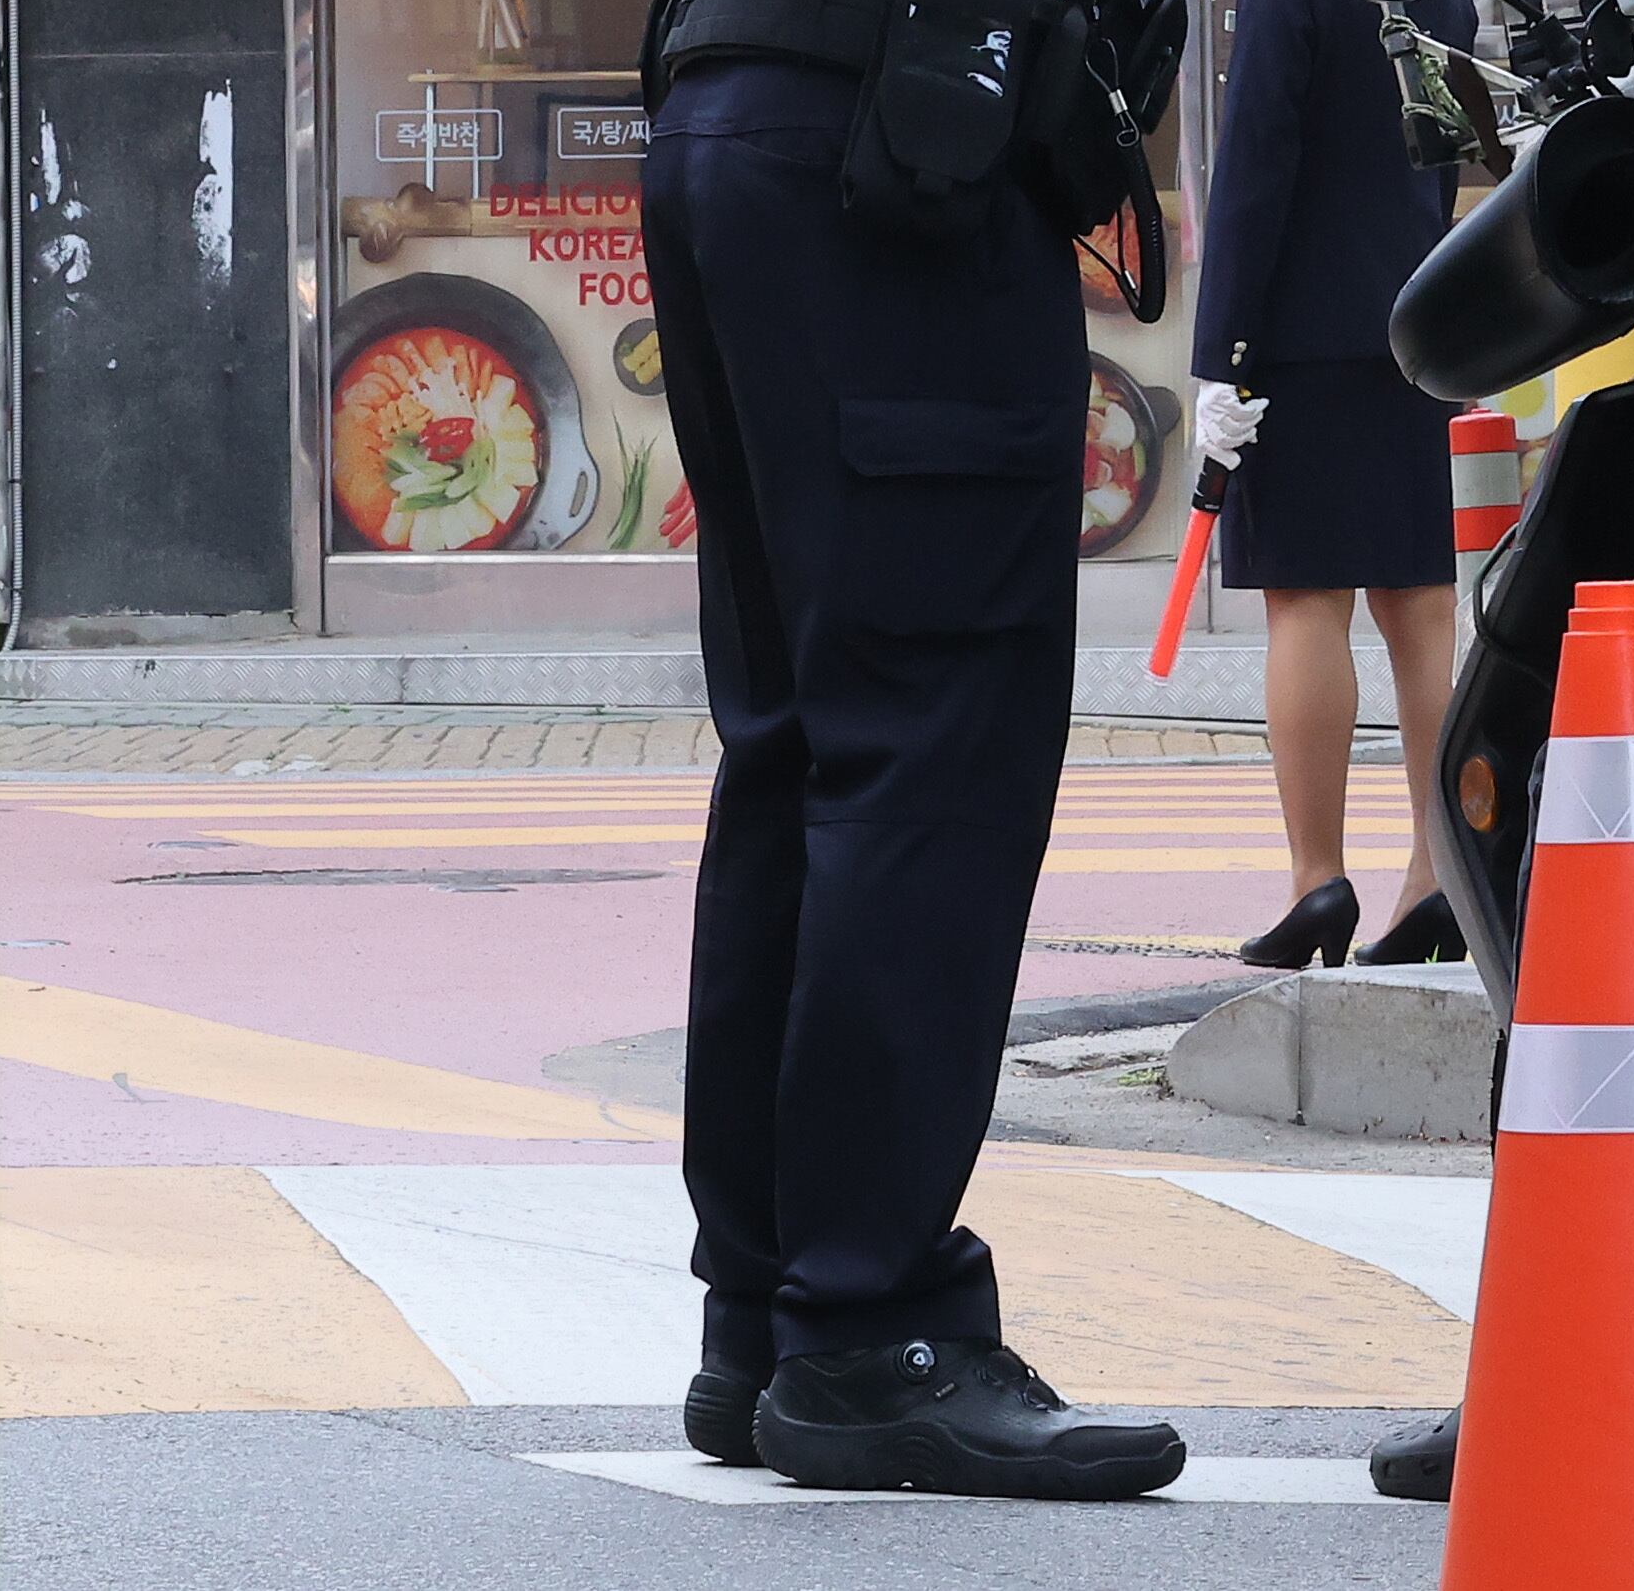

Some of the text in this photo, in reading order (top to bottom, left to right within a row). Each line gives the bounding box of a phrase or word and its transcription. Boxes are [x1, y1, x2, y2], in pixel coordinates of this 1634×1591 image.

[396, 120, 480, 148] 즉석반찬
[572, 119, 651, 145] 국/탕/찌
[489, 182, 643, 217] DELICIO
[529, 227, 644, 261] KOREA
[579, 272, 653, 306] FOO
